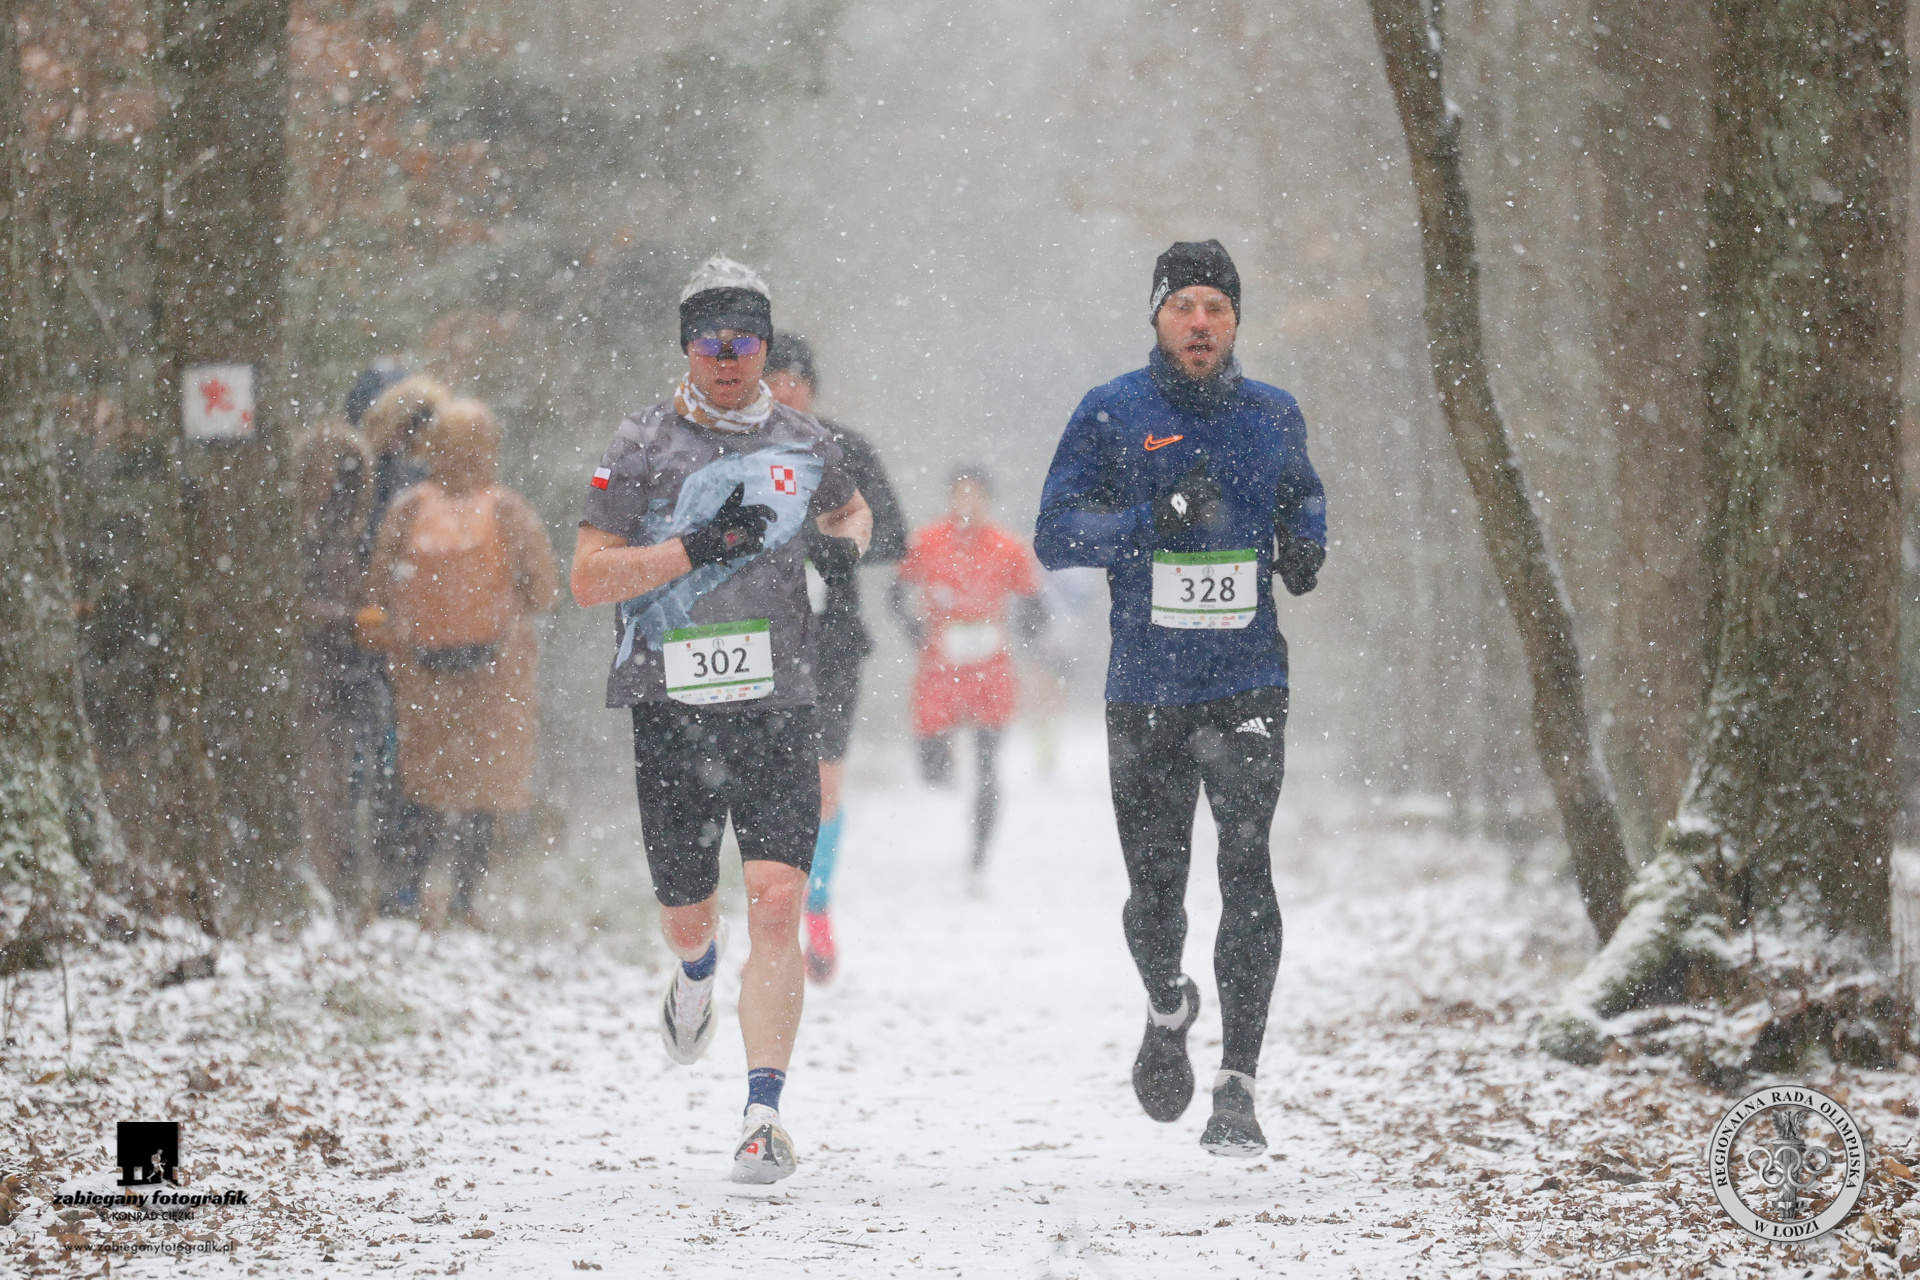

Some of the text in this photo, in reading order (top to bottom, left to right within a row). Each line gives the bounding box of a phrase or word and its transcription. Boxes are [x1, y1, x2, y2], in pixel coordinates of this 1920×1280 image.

[1180, 576, 1236, 603] 328
[691, 647, 750, 679] 302
[1235, 726, 1271, 738] adidas
